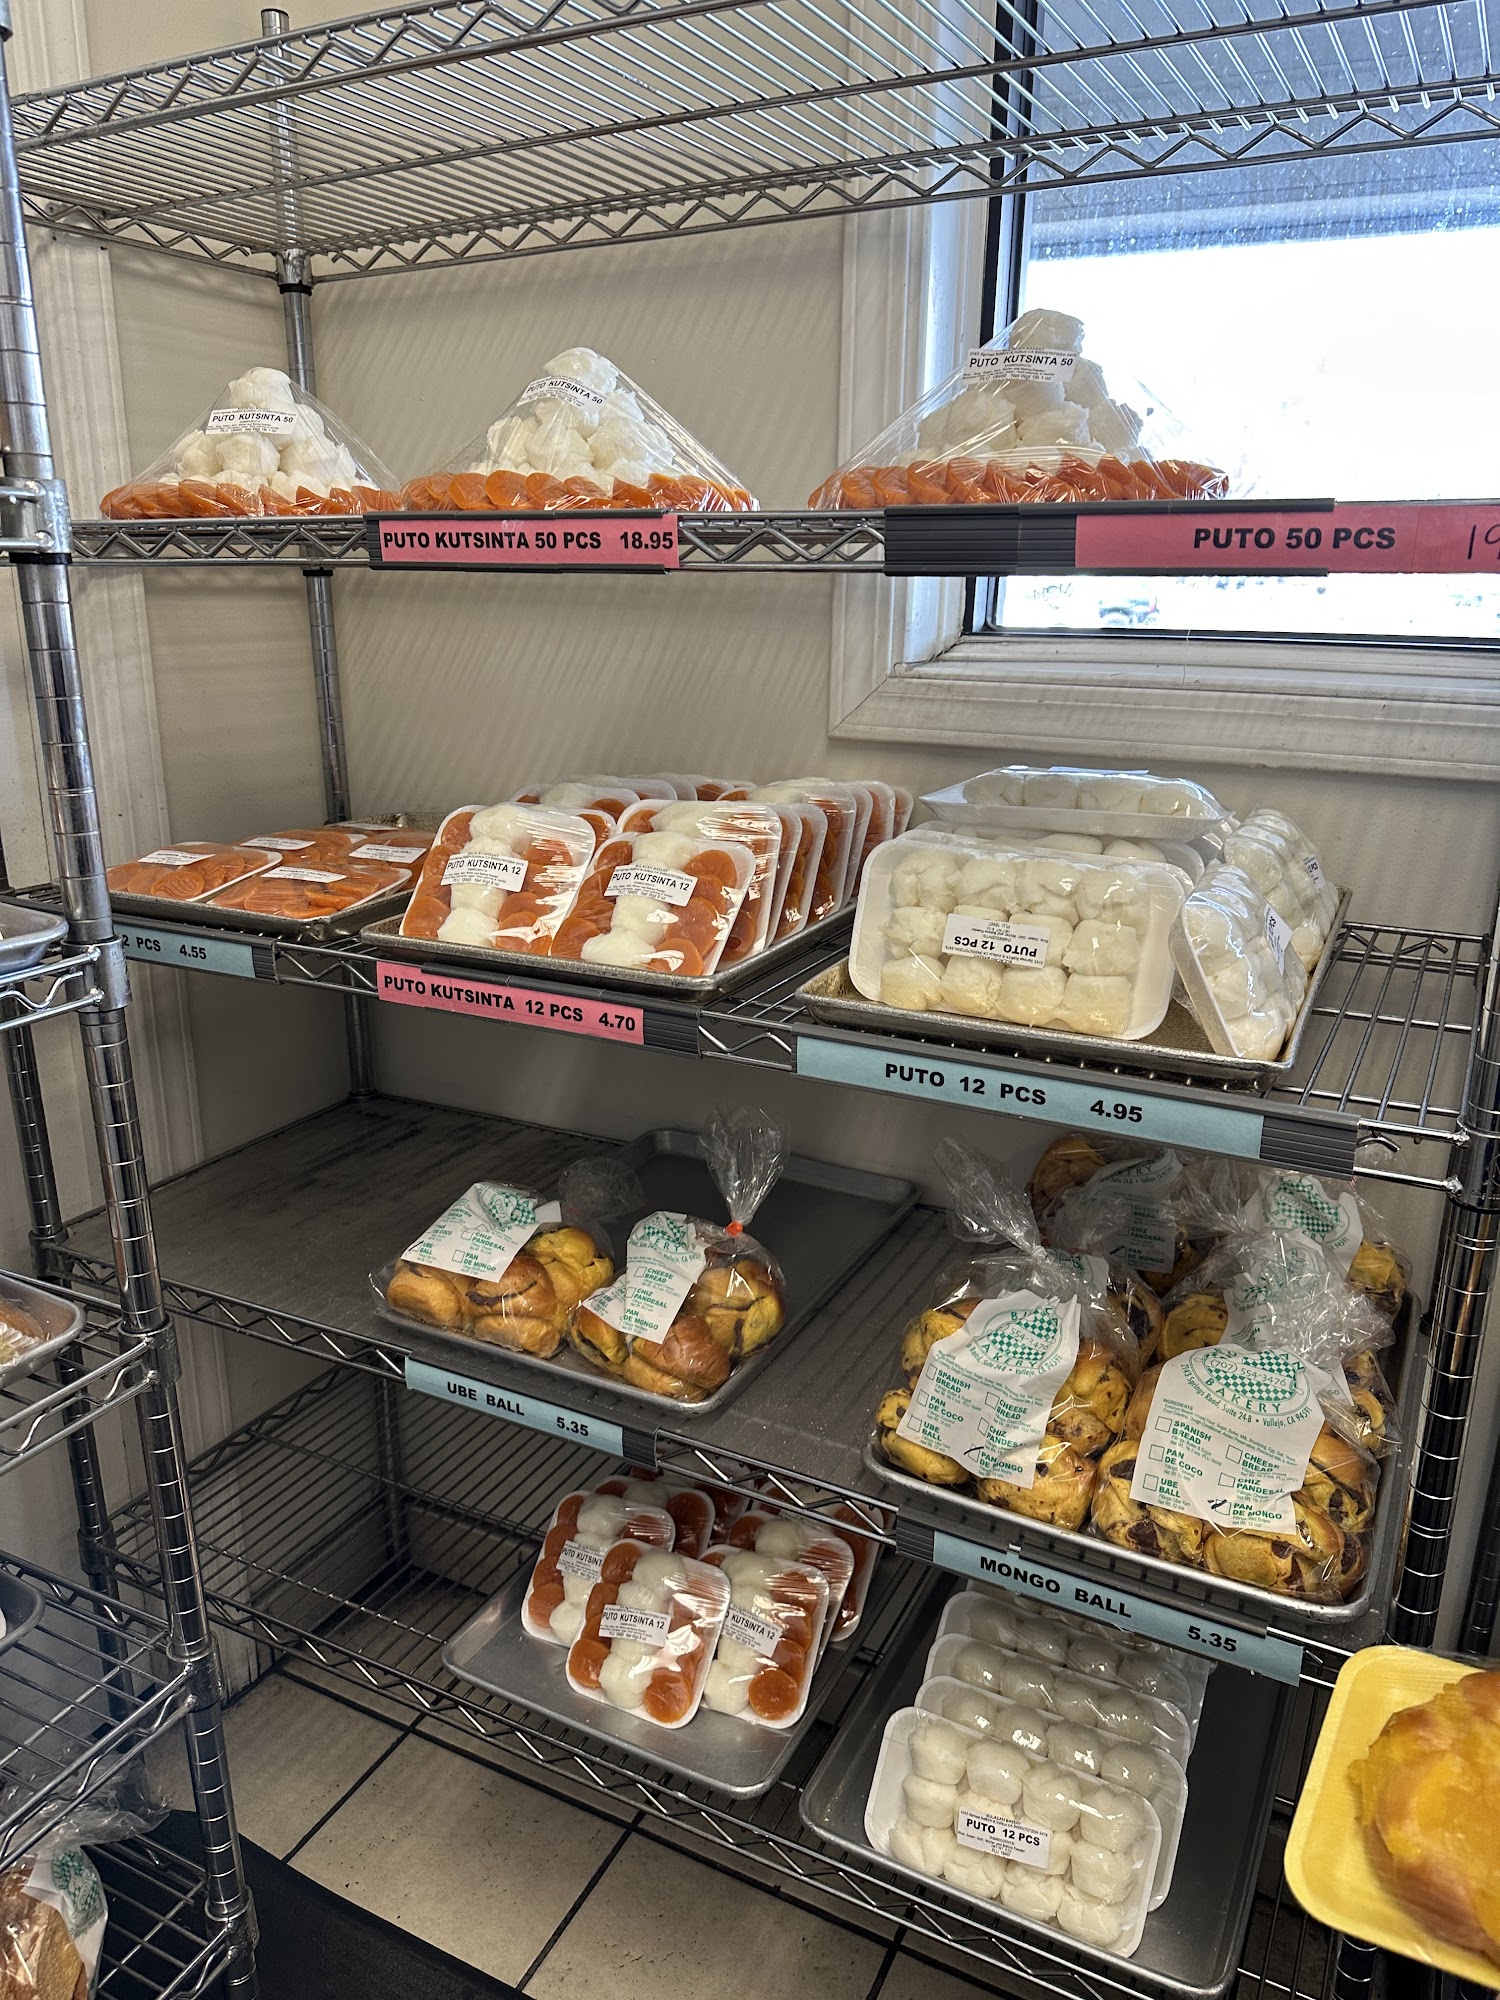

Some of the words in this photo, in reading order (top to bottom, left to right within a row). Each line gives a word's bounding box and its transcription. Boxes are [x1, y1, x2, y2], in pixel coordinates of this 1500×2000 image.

[969, 357, 999, 368] PUTO
[1003, 355, 1057, 365] KUTSINTA
[1060, 358, 1073, 366] 50
[526, 382, 546, 393] PUTO
[548, 380, 590, 399] KUTSINTA
[591, 396, 603, 404] 50
[212, 414, 235, 422] PUTO
[238, 413, 281, 422] KUTSINTA
[383, 532, 430, 549] PUTO
[435, 532, 530, 549] KUTSINTA
[535, 532, 557, 549] 50
[563, 532, 602, 549] PCS
[620, 531, 674, 550] 18.95
[1193, 527, 1276, 549] PUTO
[1285, 527, 1322, 549] 50
[1332, 527, 1397, 549] PCS
[447, 860, 465, 869] PUTO
[467, 859, 508, 872] KUTSINTA
[511, 866, 521, 875] 12
[612, 872, 632, 882] PUTO
[634, 872, 676, 888] KUTSINTA
[679, 882, 690, 891] 12
[136, 936, 161, 952] PCS
[179, 944, 207, 960] 4.55
[954, 936, 978, 948] PCS
[981, 940, 995, 951] 12
[1003, 944, 1037, 957] PUTO
[384, 975, 426, 995] PUTO
[431, 983, 515, 1011] KUTSINTA
[525, 999, 544, 1016] 12
[550, 1003, 584, 1022] PCS
[598, 1012, 636, 1031] 4.70
[885, 1063, 945, 1087] PUTO
[960, 1076, 986, 1095] 12
[1000, 1083, 1047, 1106] PCS
[1090, 1099, 1143, 1123] 4.95
[475, 1232, 492, 1240] CHIZ
[1131, 1226, 1147, 1234] CHIZ
[472, 1237, 506, 1251] PANDESAL
[1131, 1233, 1165, 1242] PANDESAL
[419, 1247, 433, 1255] BALL
[465, 1252, 479, 1260] PAN
[1138, 1254, 1165, 1263] MONGO
[474, 1260, 497, 1272] MONGO
[644, 1274, 667, 1283] BREAD
[647, 1268, 674, 1280] CHEESE
[636, 1288, 654, 1297] CHIZ
[634, 1294, 668, 1309] PANDESAL
[634, 1316, 659, 1330] MONGO
[1010, 1327, 1049, 1350] 554-3476
[982, 1343, 1038, 1368] AKERY
[1015, 1368, 1036, 1378] Vallejo,
[1038, 1366, 1047, 1375] CA
[1045, 1355, 1063, 1370] 94591
[1210, 1359, 1238, 1373] (707)
[1241, 1367, 1287, 1387] 554-3476
[936, 1377, 961, 1393] BREAD
[938, 1370, 971, 1390] SPANISH
[930, 1395, 946, 1407] PAN
[1187, 1376, 1205, 1396] Springs
[1204, 1393, 1221, 1409] Road,
[1222, 1404, 1238, 1417] Suite
[1238, 1411, 1253, 1423] 24-B
[1263, 1417, 1286, 1428] Vallejo,
[1287, 1416, 1296, 1425] CA
[1296, 1405, 1312, 1421] 94591
[1205, 1378, 1281, 1413] BAKERY
[447, 1381, 478, 1401] UBE
[486, 1393, 525, 1416] BALL
[556, 1416, 589, 1437] 5.35
[928, 1403, 940, 1412] DE
[941, 1408, 964, 1423] COCO
[996, 1407, 1021, 1420] BREAD
[999, 1399, 1028, 1415] CHEESE
[924, 1421, 940, 1434] UBE
[989, 1425, 1007, 1438] CHIZ
[1174, 1420, 1212, 1442] SPANISH
[921, 1429, 942, 1441] BALL
[1172, 1427, 1201, 1445] BREAD
[981, 1451, 998, 1463] PAN
[1166, 1448, 1185, 1459] PAN
[1244, 1452, 1280, 1469] CHEESE
[979, 1458, 990, 1468] DE
[993, 1461, 1023, 1473] MONGO
[1165, 1456, 1177, 1465] DE
[1179, 1461, 1203, 1476] COCO
[1242, 1459, 1273, 1472] BREAD
[1161, 1478, 1179, 1489] UBE
[1236, 1483, 1285, 1495] PANDESAL
[1238, 1478, 1261, 1486] CHIZ
[1159, 1486, 1181, 1498] BALL
[1233, 1502, 1253, 1511] PAN
[1247, 1510, 1282, 1520] MONGO
[562, 1548, 575, 1558] PUTO
[576, 1552, 603, 1567] KUTSINT
[980, 1556, 1061, 1593] MONGO
[1074, 1587, 1133, 1619] BALL
[1187, 1625, 1238, 1652] 5.35
[603, 1611, 618, 1621] PUTO
[620, 1614, 654, 1627] KUTSINTA
[656, 1621, 665, 1630] 12
[731, 1613, 765, 1636] KUTSINTA
[767, 1630, 776, 1640] 12
[966, 1818, 996, 1834] PUTO
[1002, 1828, 1015, 1840] 12
[1018, 1832, 1040, 1846] PCS
